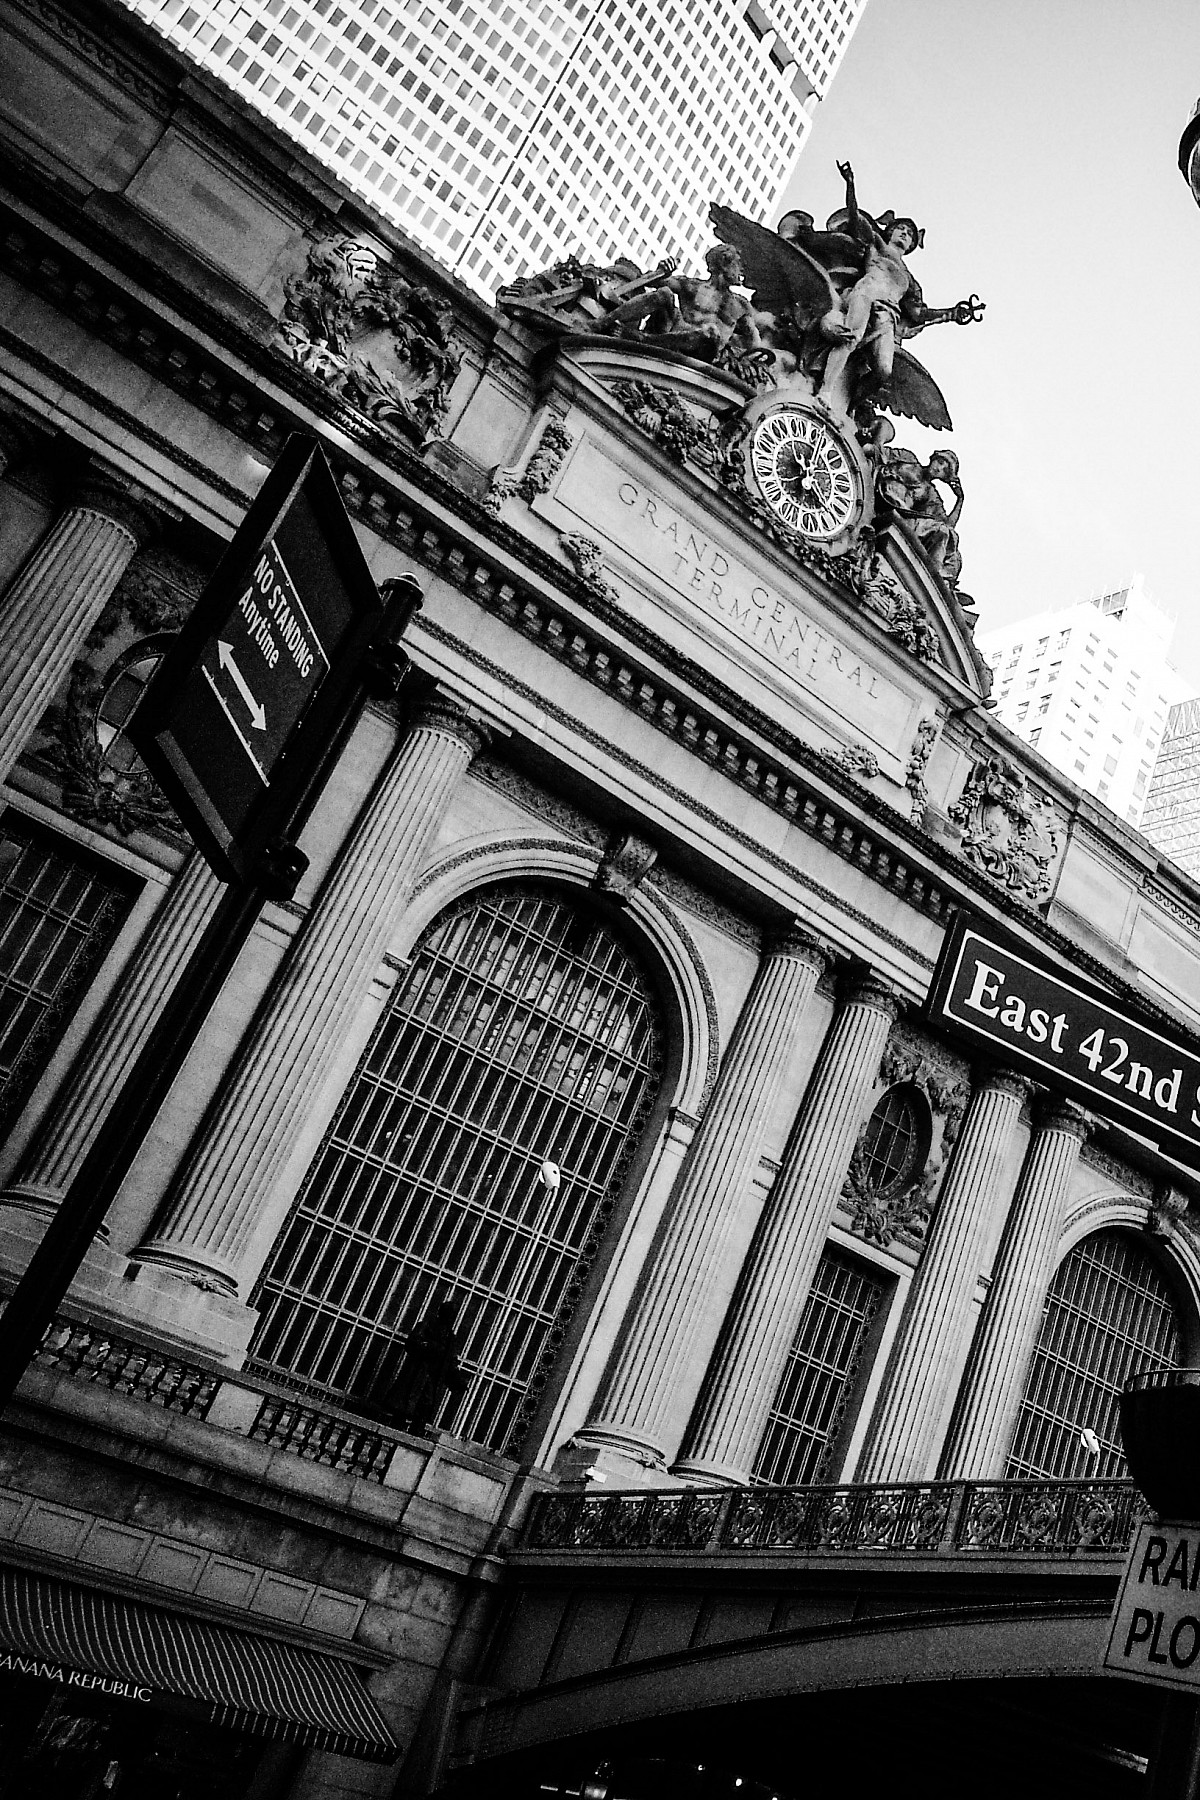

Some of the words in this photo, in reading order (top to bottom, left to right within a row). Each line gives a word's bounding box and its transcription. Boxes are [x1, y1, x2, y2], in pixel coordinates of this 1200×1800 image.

[238, 586, 281, 670] Anytime
[253, 553, 274, 595] NO
[268, 584, 316, 679] STANDING
[618, 482, 731, 578] GRAND
[751, 586, 880, 700] CENTRAL
[671, 550, 821, 682] TERMINAL
[964, 959, 1069, 1054] East
[1078, 1028, 1183, 1113] 42nd
[0, 1653, 64, 1683] ANANA
[68, 1671, 153, 1702] REPUBLIC
